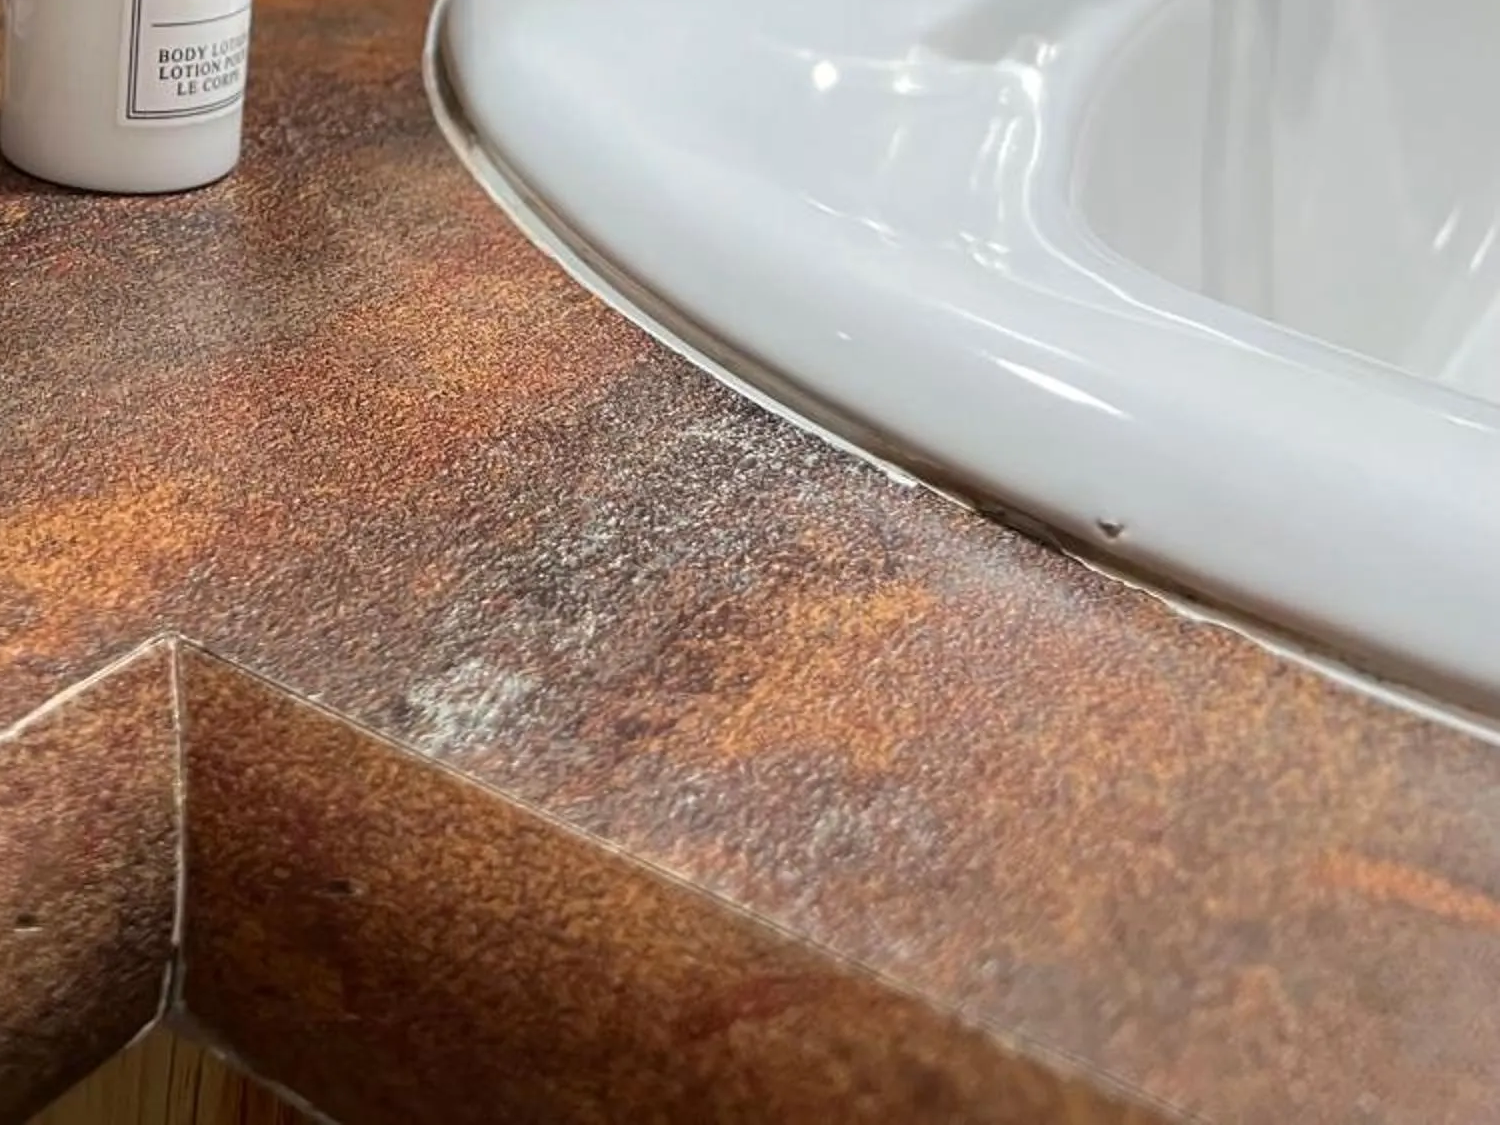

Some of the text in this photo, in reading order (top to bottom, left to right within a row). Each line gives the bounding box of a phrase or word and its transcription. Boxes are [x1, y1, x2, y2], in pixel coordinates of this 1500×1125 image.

[159, 44, 206, 64] BODY
[159, 59, 221, 80] LOTION
[177, 79, 197, 96] LE
